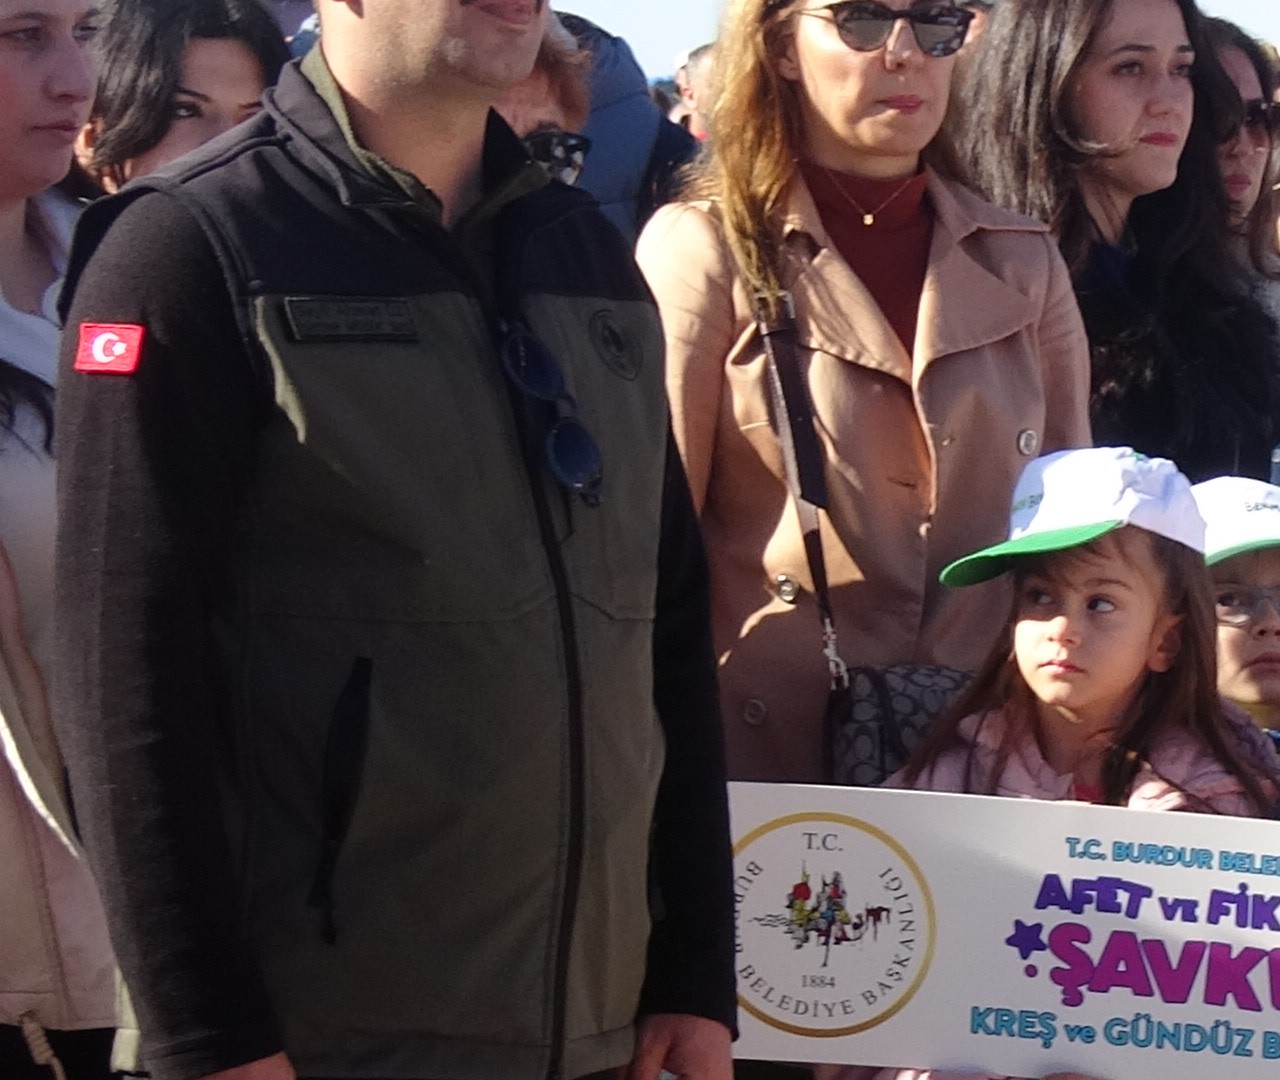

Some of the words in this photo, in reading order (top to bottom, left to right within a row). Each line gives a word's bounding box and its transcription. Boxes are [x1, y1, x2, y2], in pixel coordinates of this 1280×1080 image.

[803, 833, 843, 851] T.C.
[1066, 837, 1107, 861] T.C.
[1112, 841, 1212, 869] BURDUR
[1034, 873, 1153, 918] AFET
[739, 965, 855, 1018] BELEDİYE
[801, 975, 835, 988] 1884
[970, 1007, 1057, 1048] KREŞ
[1064, 1024, 1095, 1043] ve
[1104, 1018, 1252, 1056] GÜNDÜZ
